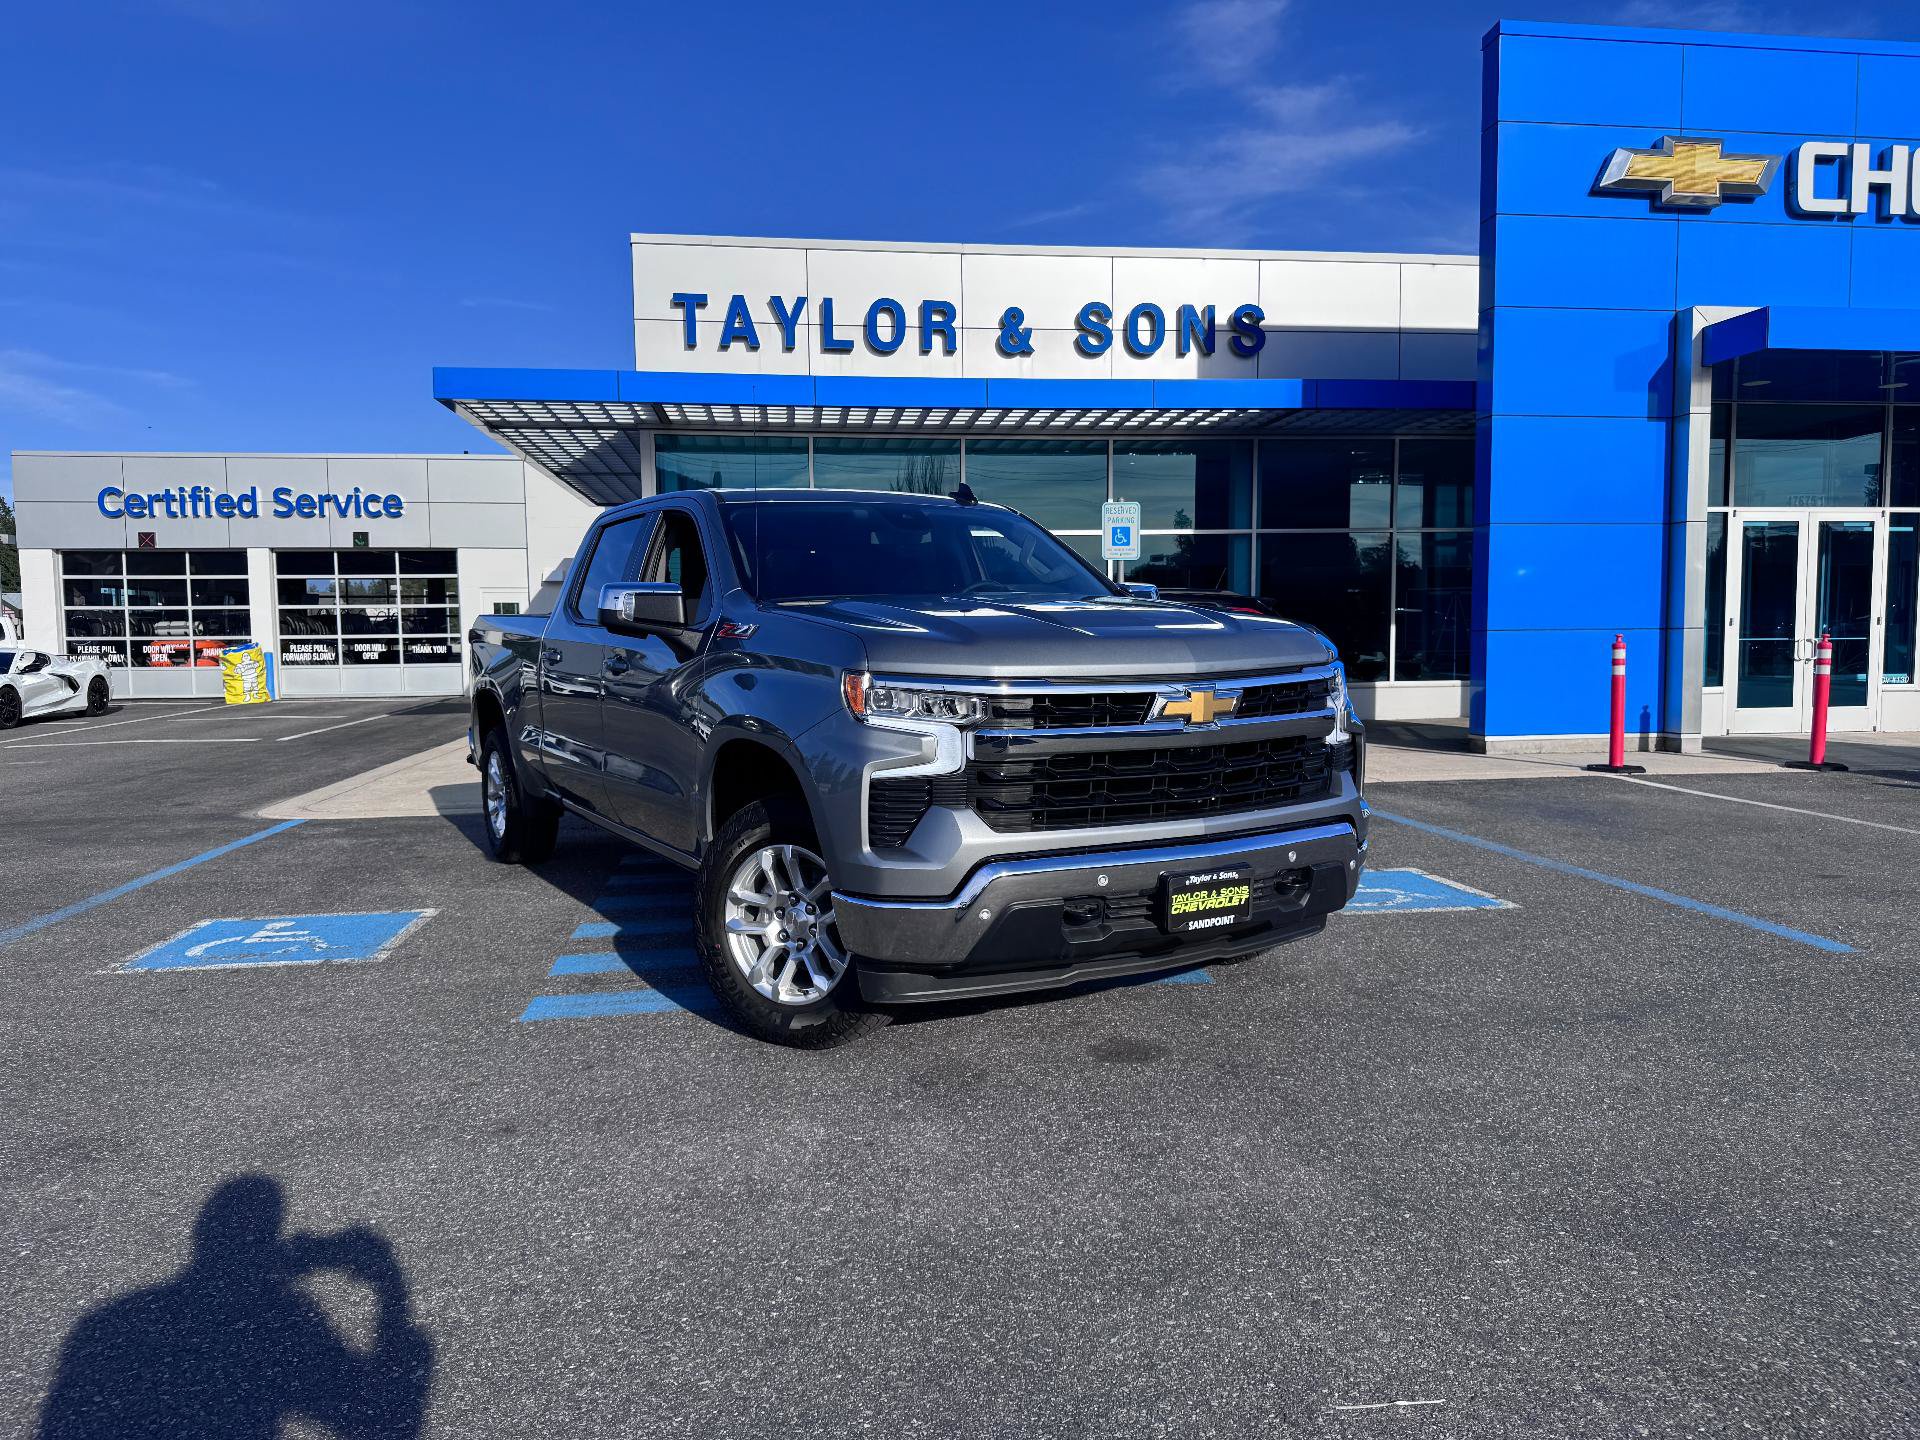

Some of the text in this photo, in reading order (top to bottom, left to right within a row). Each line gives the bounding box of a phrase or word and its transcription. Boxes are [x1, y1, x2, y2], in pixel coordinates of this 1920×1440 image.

[672, 293, 1266, 356] TAYLOR & SONS
[97, 486, 404, 519] Certified Service
[1105, 506, 1137, 515] RESERVED
[1107, 516, 1136, 524] PARKING
[77, 645, 117, 654] PLEASE PULL
[142, 645, 160, 654] DOOR
[160, 644, 176, 654] WILL
[289, 644, 329, 653] PLEASE PULL
[354, 643, 387, 652] DOOR WILL
[412, 644, 433, 654] THANK
[282, 652, 336, 662] FORWARD SLOWLY
[362, 651, 379, 660] OPEN
[1171, 886, 1249, 904] TAYLOR & SONS
[1171, 894, 1250, 915] CHEVROLET
[1188, 914, 1236, 931] SANDPOINT
